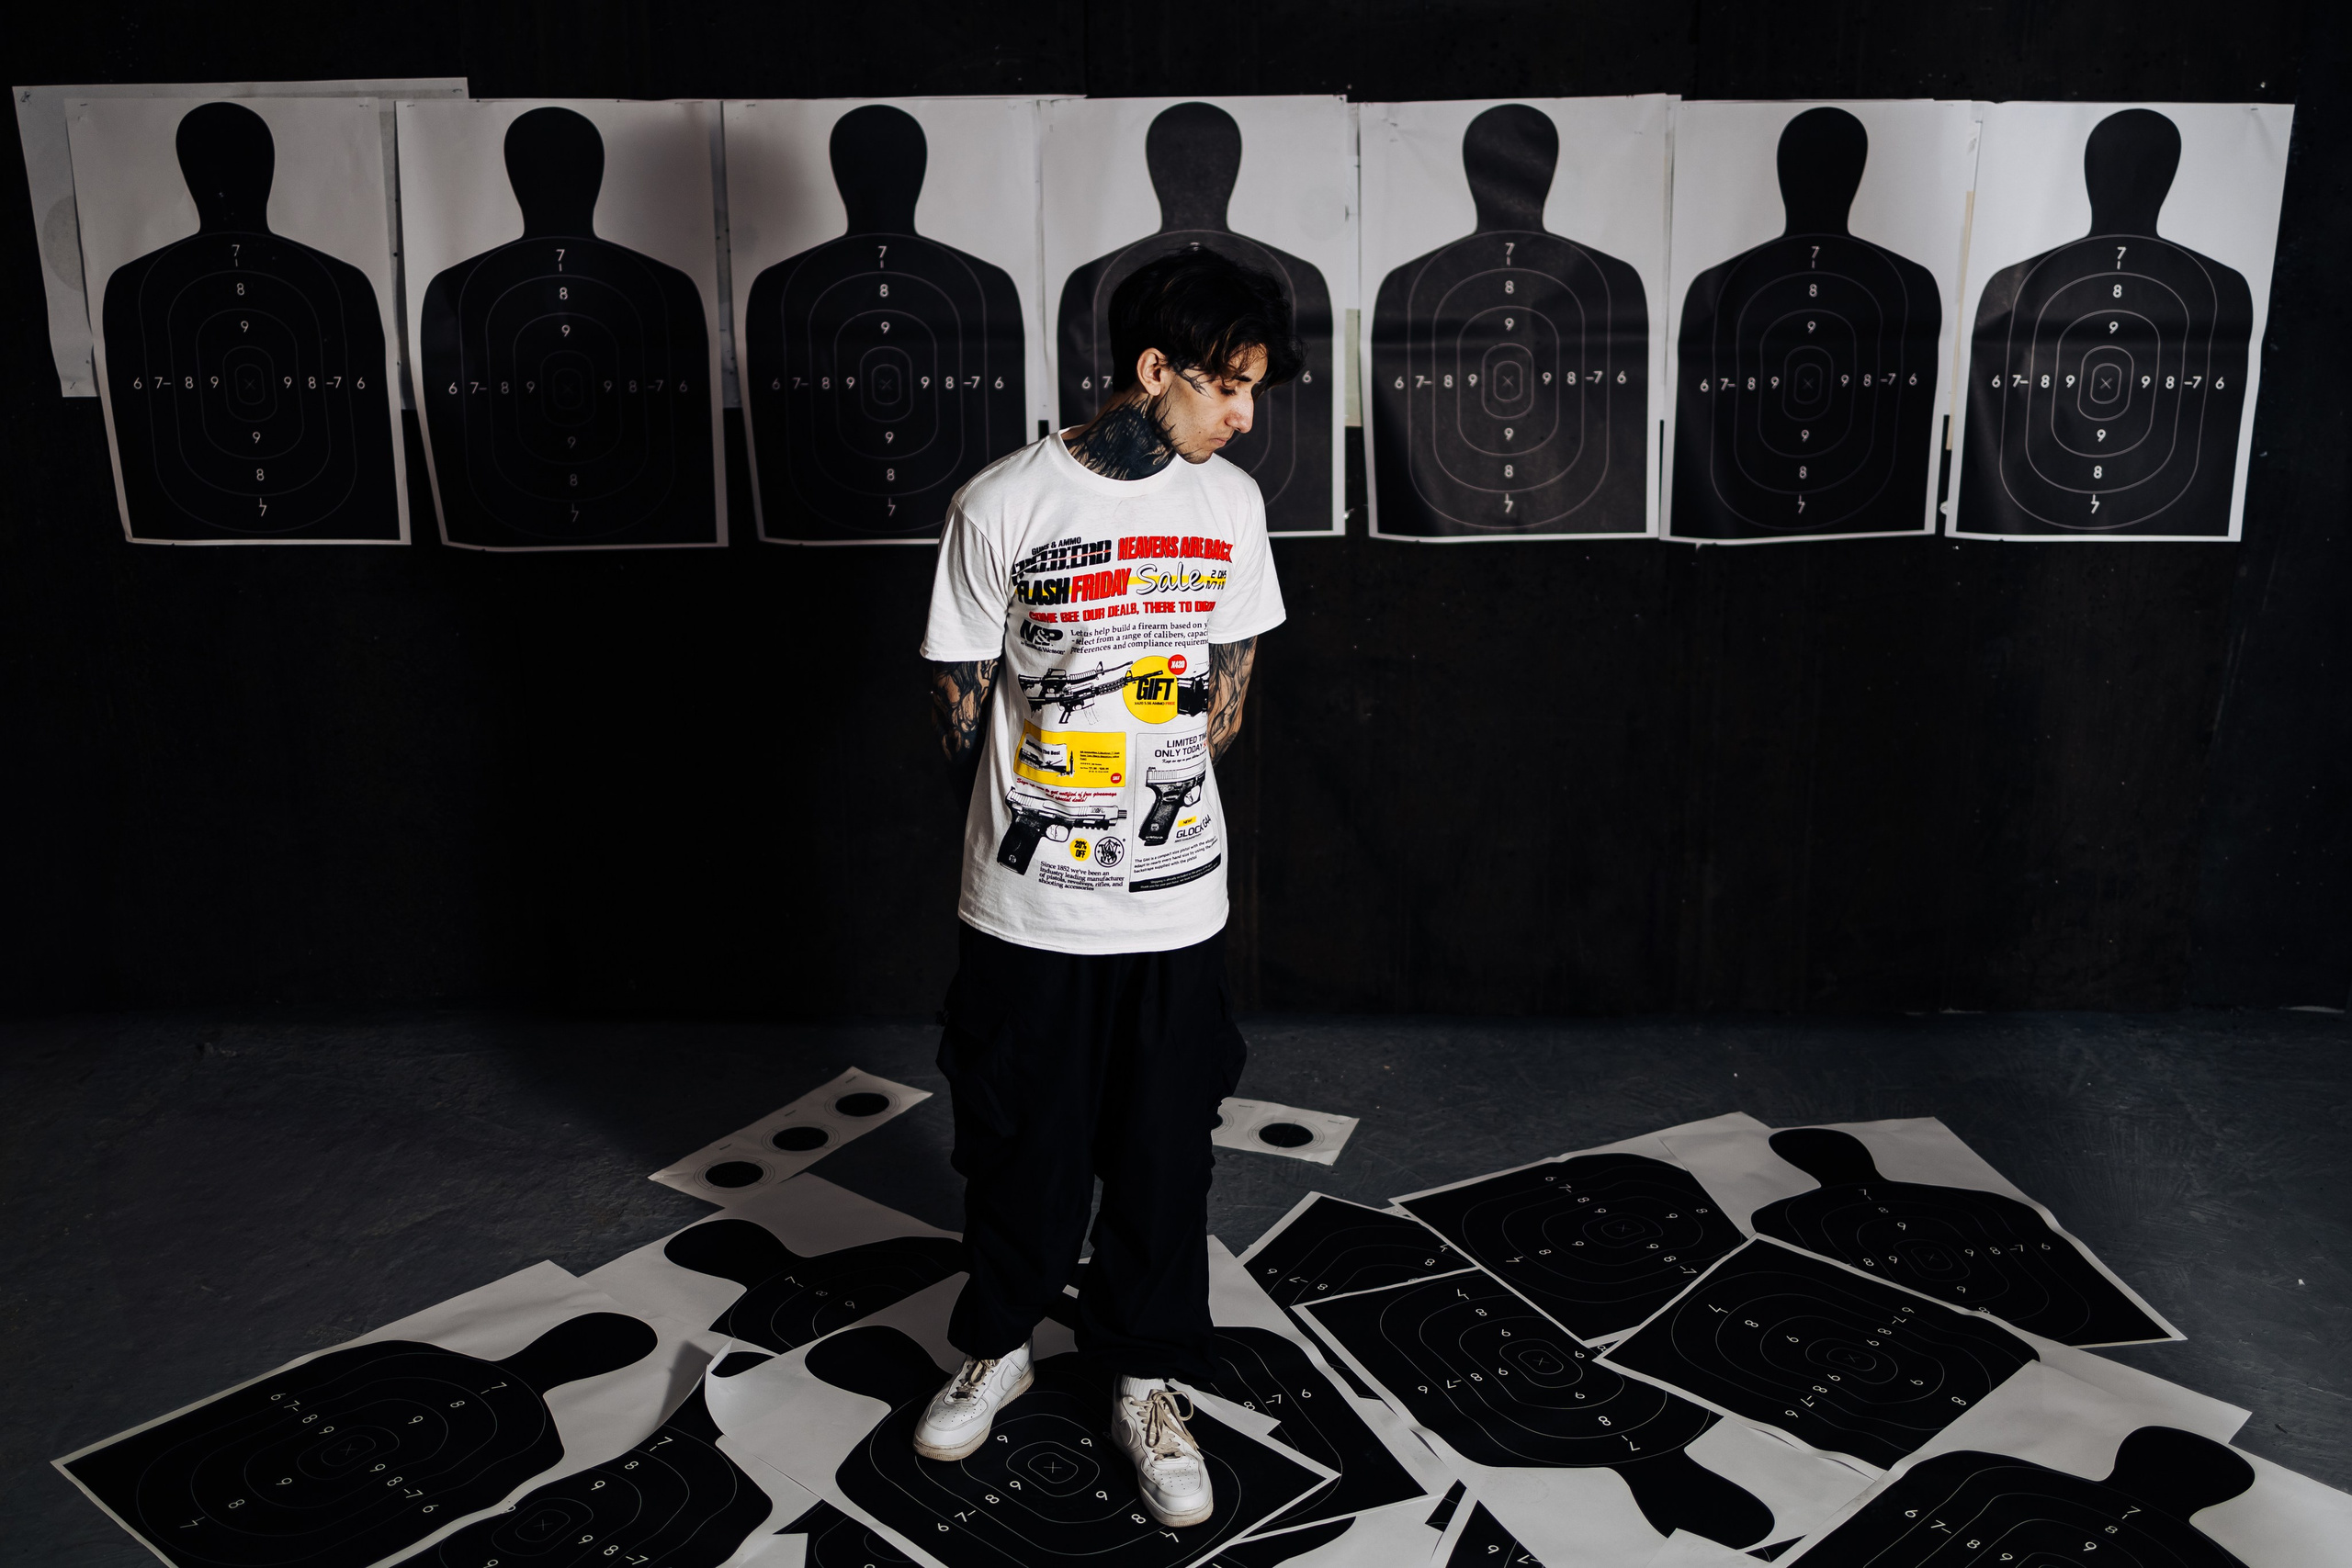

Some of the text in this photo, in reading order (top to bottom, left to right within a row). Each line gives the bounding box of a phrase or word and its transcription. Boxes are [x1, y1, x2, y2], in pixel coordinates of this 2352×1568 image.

[236, 282, 245, 296] 8
[559, 287, 569, 300] 8
[879, 283, 889, 298] 8
[1504, 280, 1515, 294] 8
[2112, 284, 2122, 299] 8
[240, 320, 249, 333] 9
[880, 321, 890, 333] 9
[1504, 317, 1515, 331] 9
[2109, 321, 2119, 334] 9
[133, 376, 366, 389] 6 8 9 9 8 6
[772, 376, 1004, 390] 6 8 9 9 8 6
[1081, 377, 1091, 389] 6
[1302, 370, 1312, 383] 6
[1394, 370, 1627, 389] 6 8 9 9 8 6
[1700, 373, 1917, 392] 6 6
[1991, 374, 2225, 390] 6 8 9 9 8 6
[2097, 428, 2107, 443] 9
[1058, 536, 1081, 547] AMMO
[1117, 536, 1234, 563] HEAVENS ARE BACK
[1211, 570, 1216, 579] 2
[1016, 561, 1204, 606] FLASH FRIDAY Sale
[1029, 611, 1058, 624] COME
[1060, 611, 1080, 623] SEE
[1082, 607, 1105, 622] OUR
[1107, 602, 1139, 618] DEALS,
[1143, 601, 1176, 614] THERE
[1178, 601, 1193, 613] TO
[1094, 626, 1110, 637] help
[1112, 624, 1131, 633] build
[1170, 622, 1191, 630] based
[1096, 635, 1114, 646] from
[1153, 630, 1186, 638] calibers,
[1069, 642, 1111, 654] preferences
[1113, 642, 1126, 650] and
[1127, 639, 1172, 649] compliance
[1170, 660, 1185, 669] X420
[1136, 678, 1175, 701] GIFT
[1167, 736, 1198, 749] LIMITED
[1155, 749, 1181, 758] ONLY
[1182, 743, 1203, 755] TODAY
[1176, 824, 1204, 839] GLOCK
[1202, 814, 1212, 829] G44
[1074, 840, 1087, 849] 20%
[1195, 847, 1205, 855] using
[1075, 850, 1086, 858] OFF
[1158, 852, 1172, 860] compact
[1040, 861, 1057, 869] Since
[1155, 863, 1170, 871] supplied
[1186, 855, 1197, 863] pistol
[1065, 872, 1086, 882] leading
[1038, 878, 1094, 892] shooting accessories
[985, 1494, 1000, 1505] 8
[1131, 1513, 1147, 1524] 8
